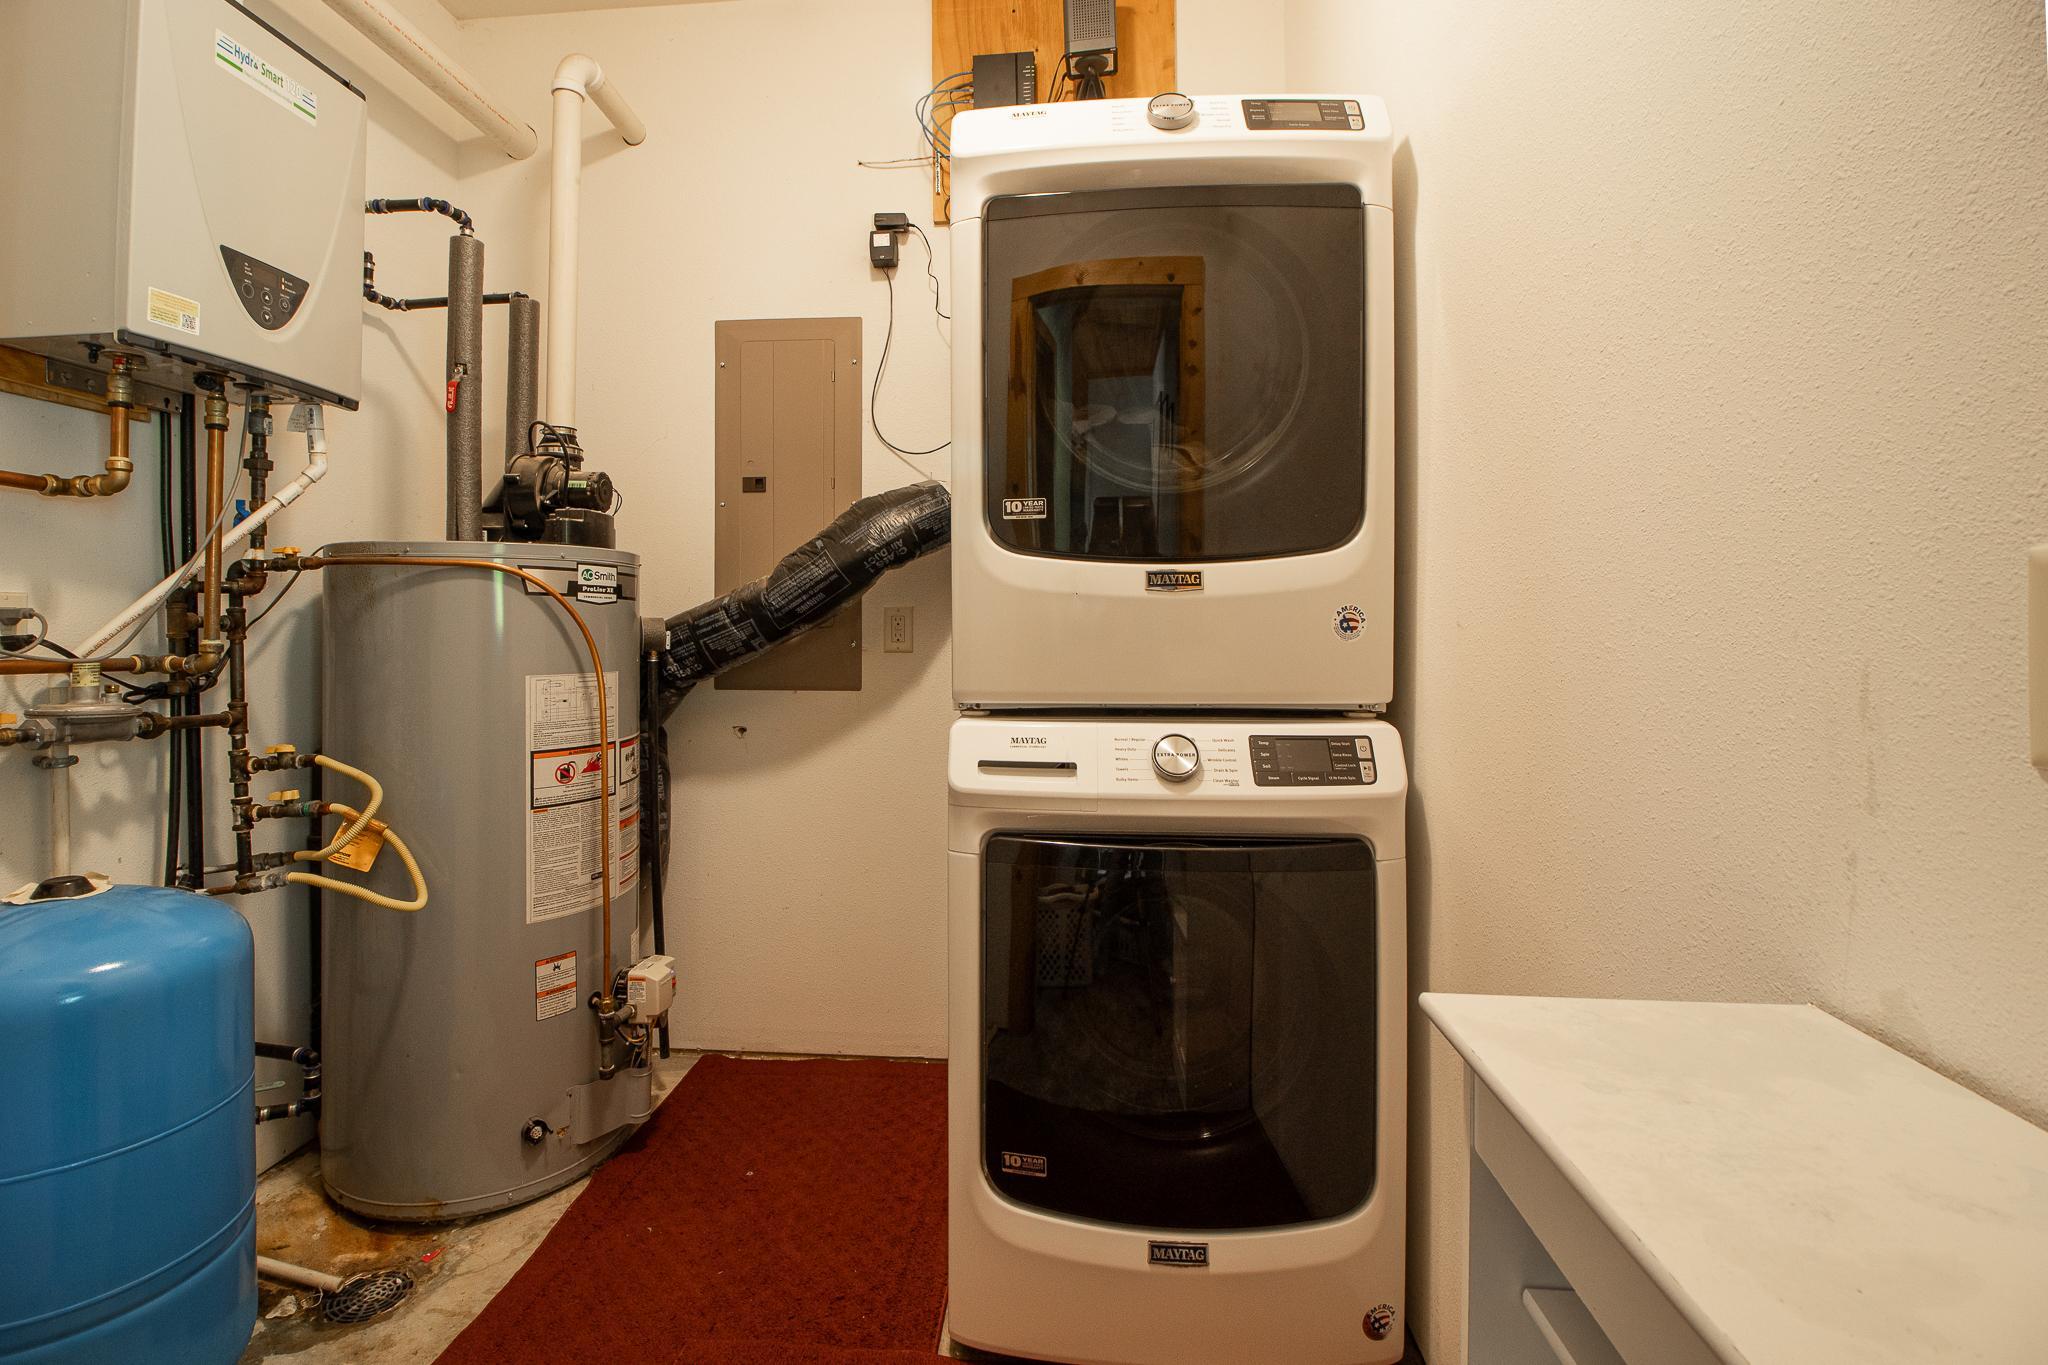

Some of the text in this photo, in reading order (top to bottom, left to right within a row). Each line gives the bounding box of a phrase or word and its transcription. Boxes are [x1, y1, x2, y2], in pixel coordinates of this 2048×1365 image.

[261, 63, 284, 88] Smart
[1004, 501, 1022, 513] 10
[1149, 574, 1201, 585] MAYTAG
[1336, 604, 1366, 624] AMERICA
[1003, 1154, 1022, 1168] 10
[1152, 1247, 1205, 1260] MAYTAG
[1369, 1303, 1396, 1319] MERICA
